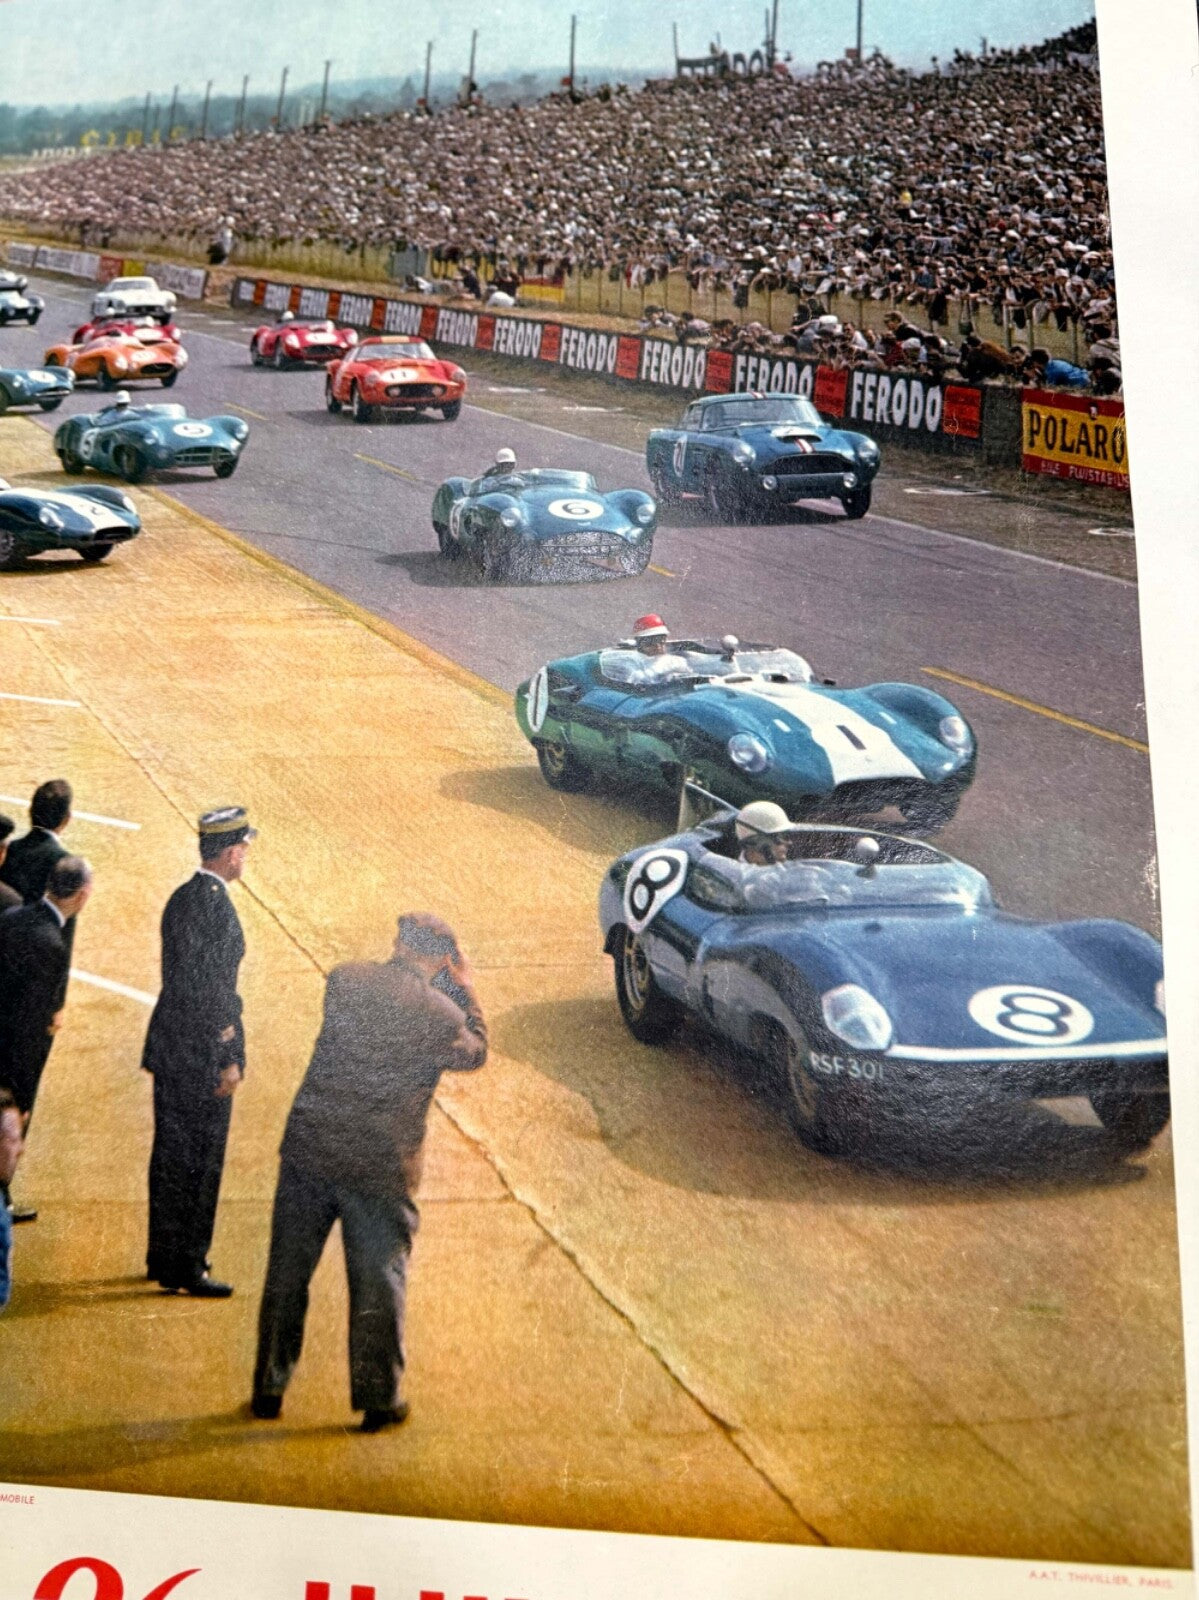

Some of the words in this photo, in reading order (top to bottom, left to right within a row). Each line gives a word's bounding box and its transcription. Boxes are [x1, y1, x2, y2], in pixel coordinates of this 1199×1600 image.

[435, 308, 478, 348] FERODO
[493, 317, 542, 359] FERODO
[559, 326, 618, 374] FERODO
[641, 339, 707, 390] FERODO
[734, 354, 814, 399] FERODO
[851, 371, 942, 432] FERODO
[183, 424, 206, 435] 5
[1028, 409, 1125, 464] POLARO
[561, 501, 592, 515] 6
[835, 724, 867, 751] 1
[629, 855, 682, 922] 8
[997, 992, 1073, 1038] 8
[809, 1050, 845, 1075] RSF
[847, 1057, 885, 1080] 301
